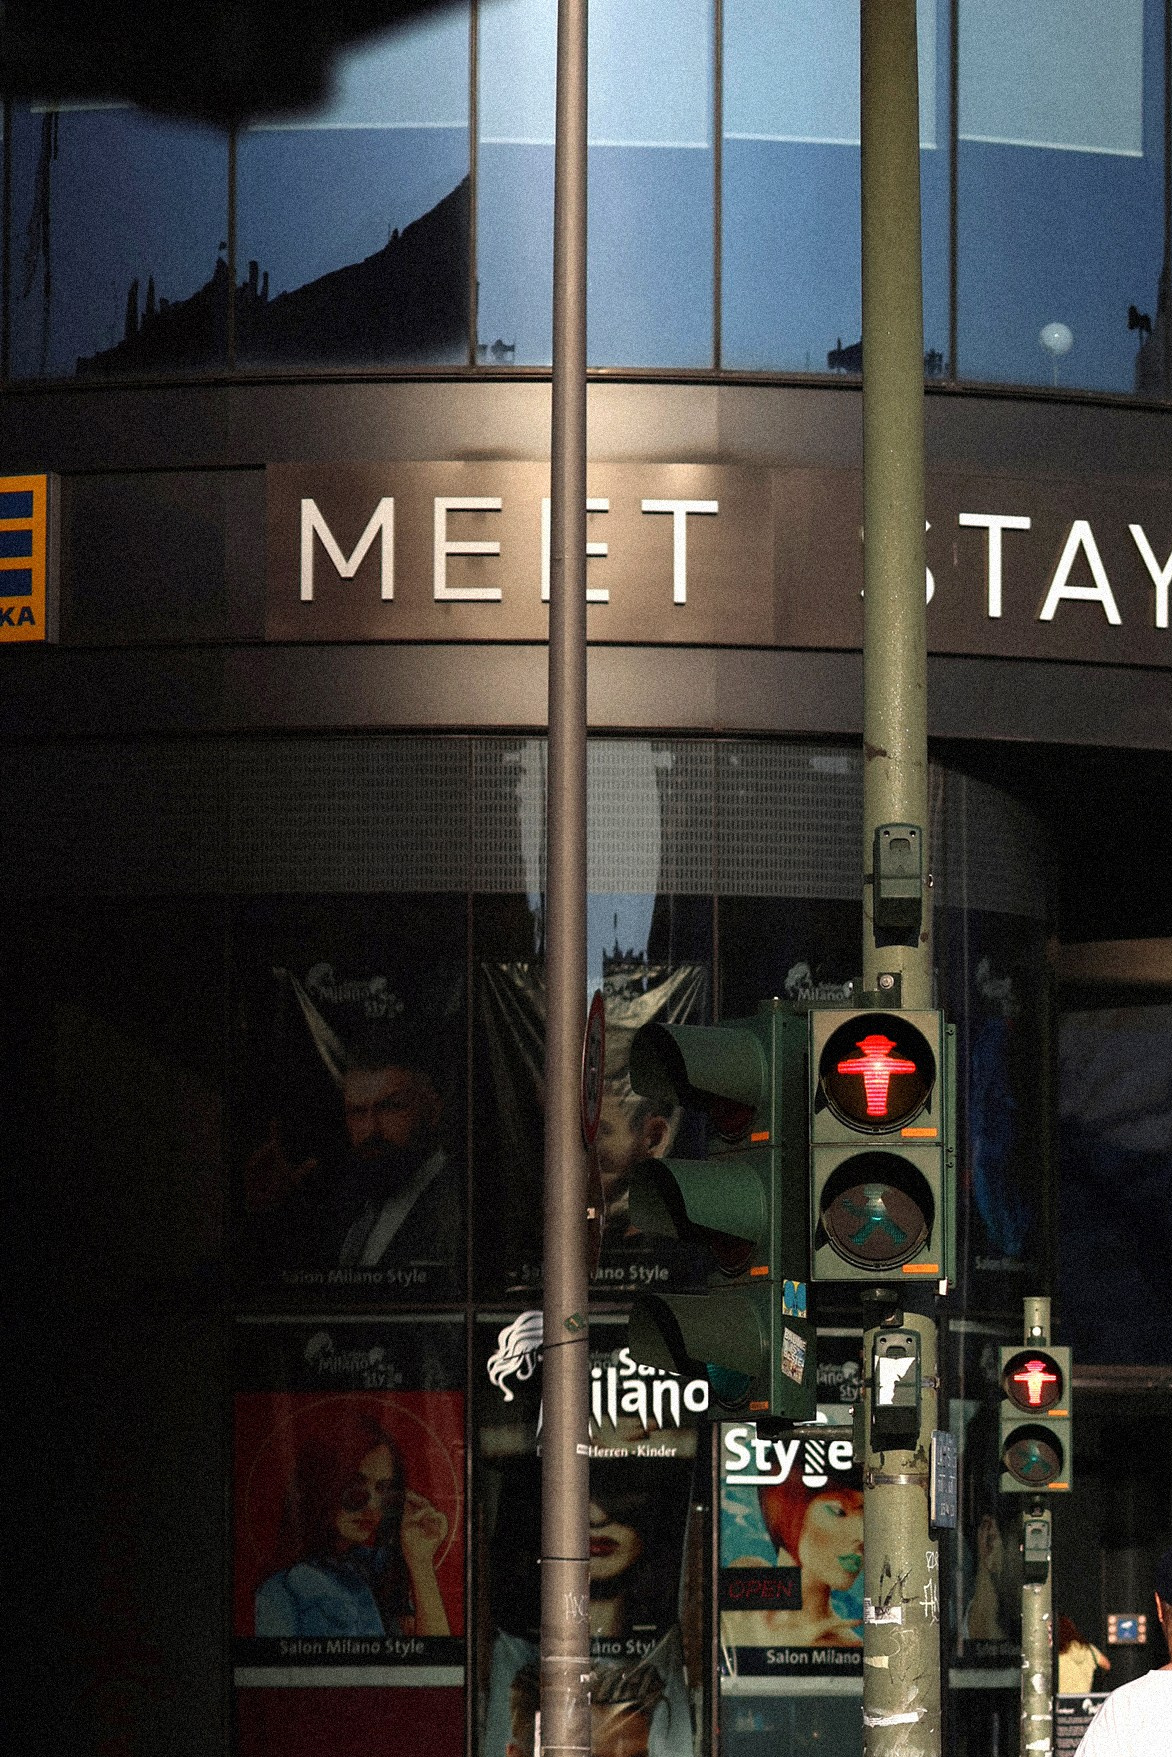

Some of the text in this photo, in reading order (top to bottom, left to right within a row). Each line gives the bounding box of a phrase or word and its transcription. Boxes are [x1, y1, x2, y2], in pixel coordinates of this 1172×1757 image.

[301, 497, 718, 604] MEET
[0, 606, 36, 627] KA
[327, 1268, 384, 1284] Milano
[387, 1268, 428, 1288] Style
[629, 1264, 669, 1284] Style
[588, 1445, 628, 1457] Herren
[637, 1445, 677, 1457] Kinder
[728, 1580, 794, 1600] OPEN
[280, 1638, 425, 1658] Salon Milano Style
[766, 1648, 861, 1665] Salon Milano
